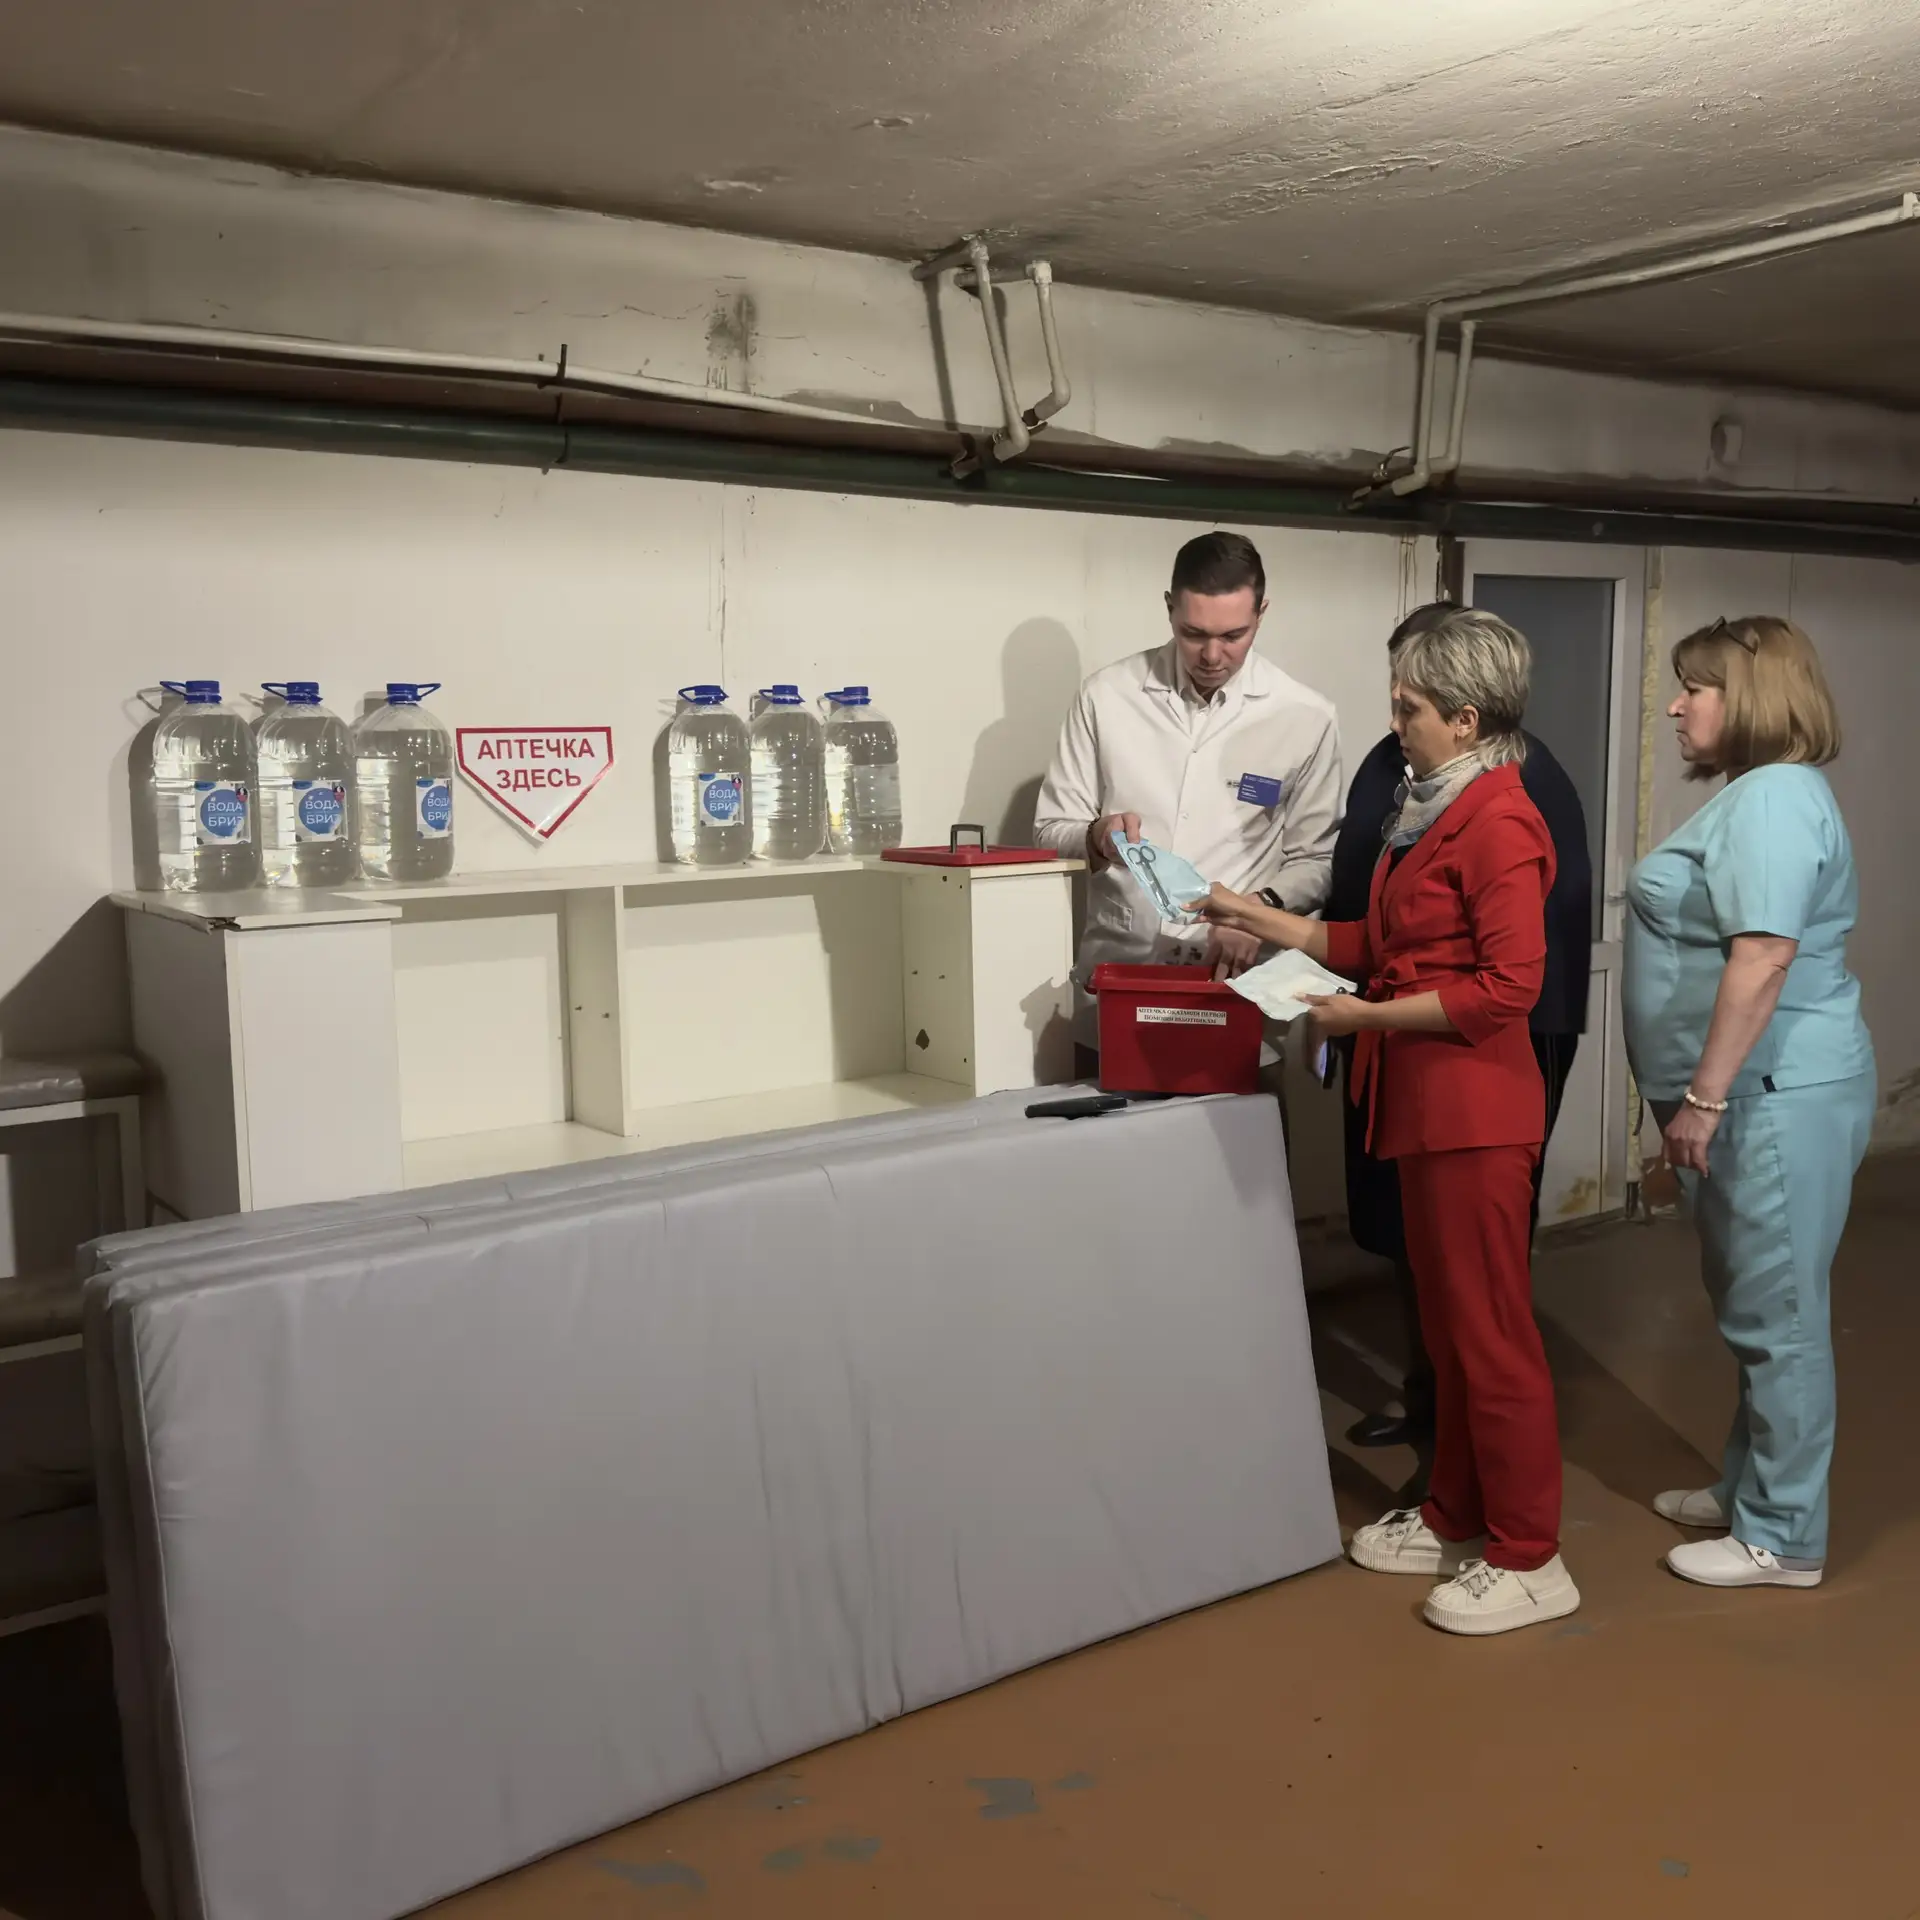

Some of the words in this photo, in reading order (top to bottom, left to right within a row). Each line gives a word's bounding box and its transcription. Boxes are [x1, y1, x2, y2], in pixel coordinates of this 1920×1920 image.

[477, 738, 595, 760] АПТЕЧКА
[496, 768, 582, 793] ЗДЕСЬ
[709, 789, 737, 799] ВОДА
[207, 802, 243, 812] ВОДА
[305, 800, 340, 810] ВОДА
[427, 797, 449, 807] ВОД
[710, 802, 738, 811] БРИ
[428, 811, 449, 821] БРИ
